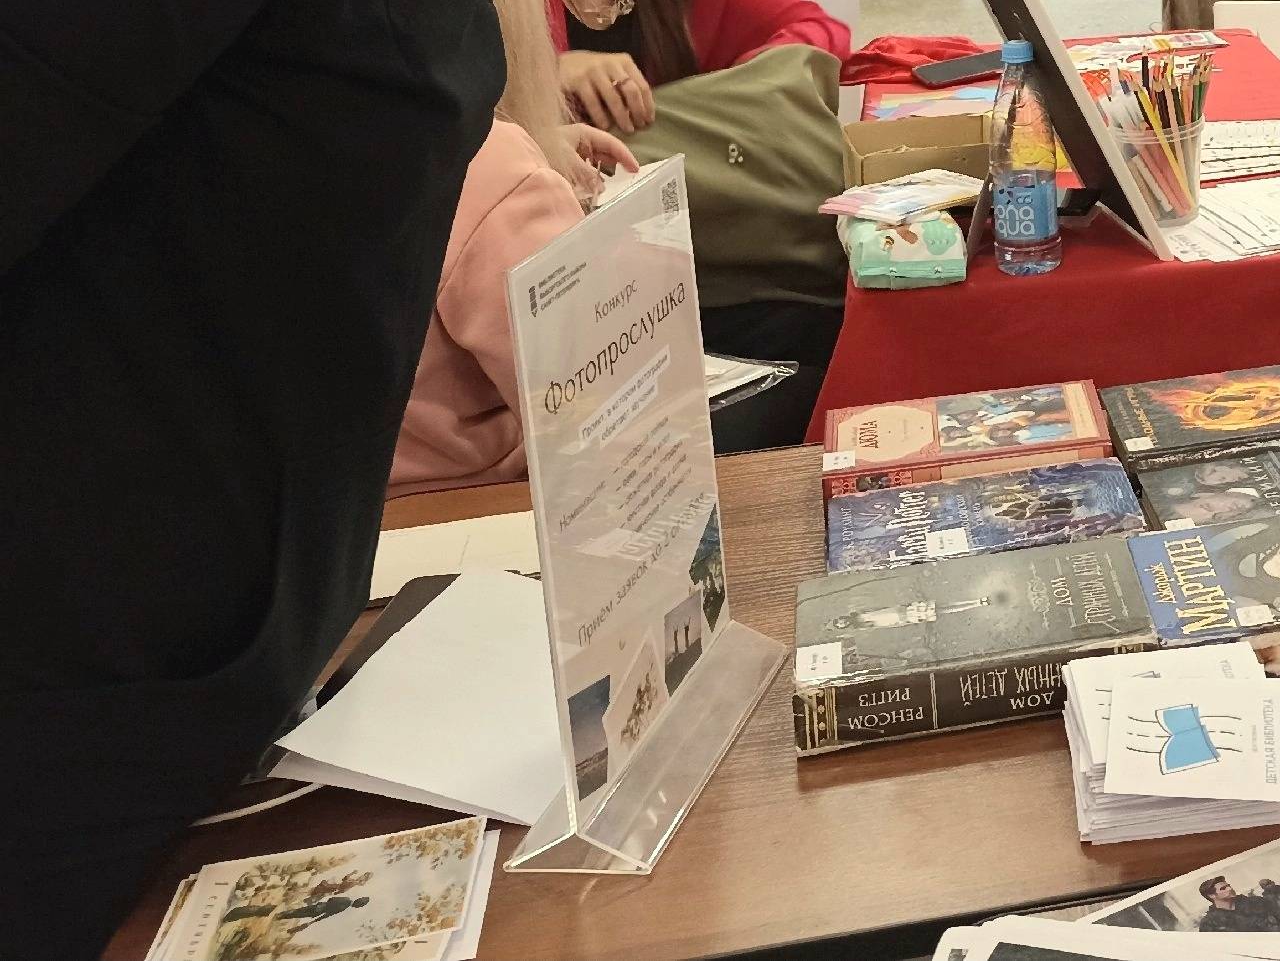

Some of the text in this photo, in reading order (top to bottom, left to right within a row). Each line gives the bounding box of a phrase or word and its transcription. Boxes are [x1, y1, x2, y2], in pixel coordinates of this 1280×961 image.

[594, 279, 638, 323] Конкурс
[544, 282, 686, 415] Фотопрослушка
[886, 490, 929, 529] Поттер
[1050, 576, 1075, 606] ДОМ
[1163, 535, 1238, 635] МАРТИН
[858, 687, 911, 708] РИГГЗ
[960, 662, 1063, 707] ННЫХ ДЕТЕЙ
[1010, 691, 1055, 711] ДОМ
[848, 706, 924, 731] РЕНСОМ
[1261, 698, 1278, 784] ДЕТСКАЯ БИБЛИОТЕКА
[185, 894, 218, 961] СЕНТЯБР
